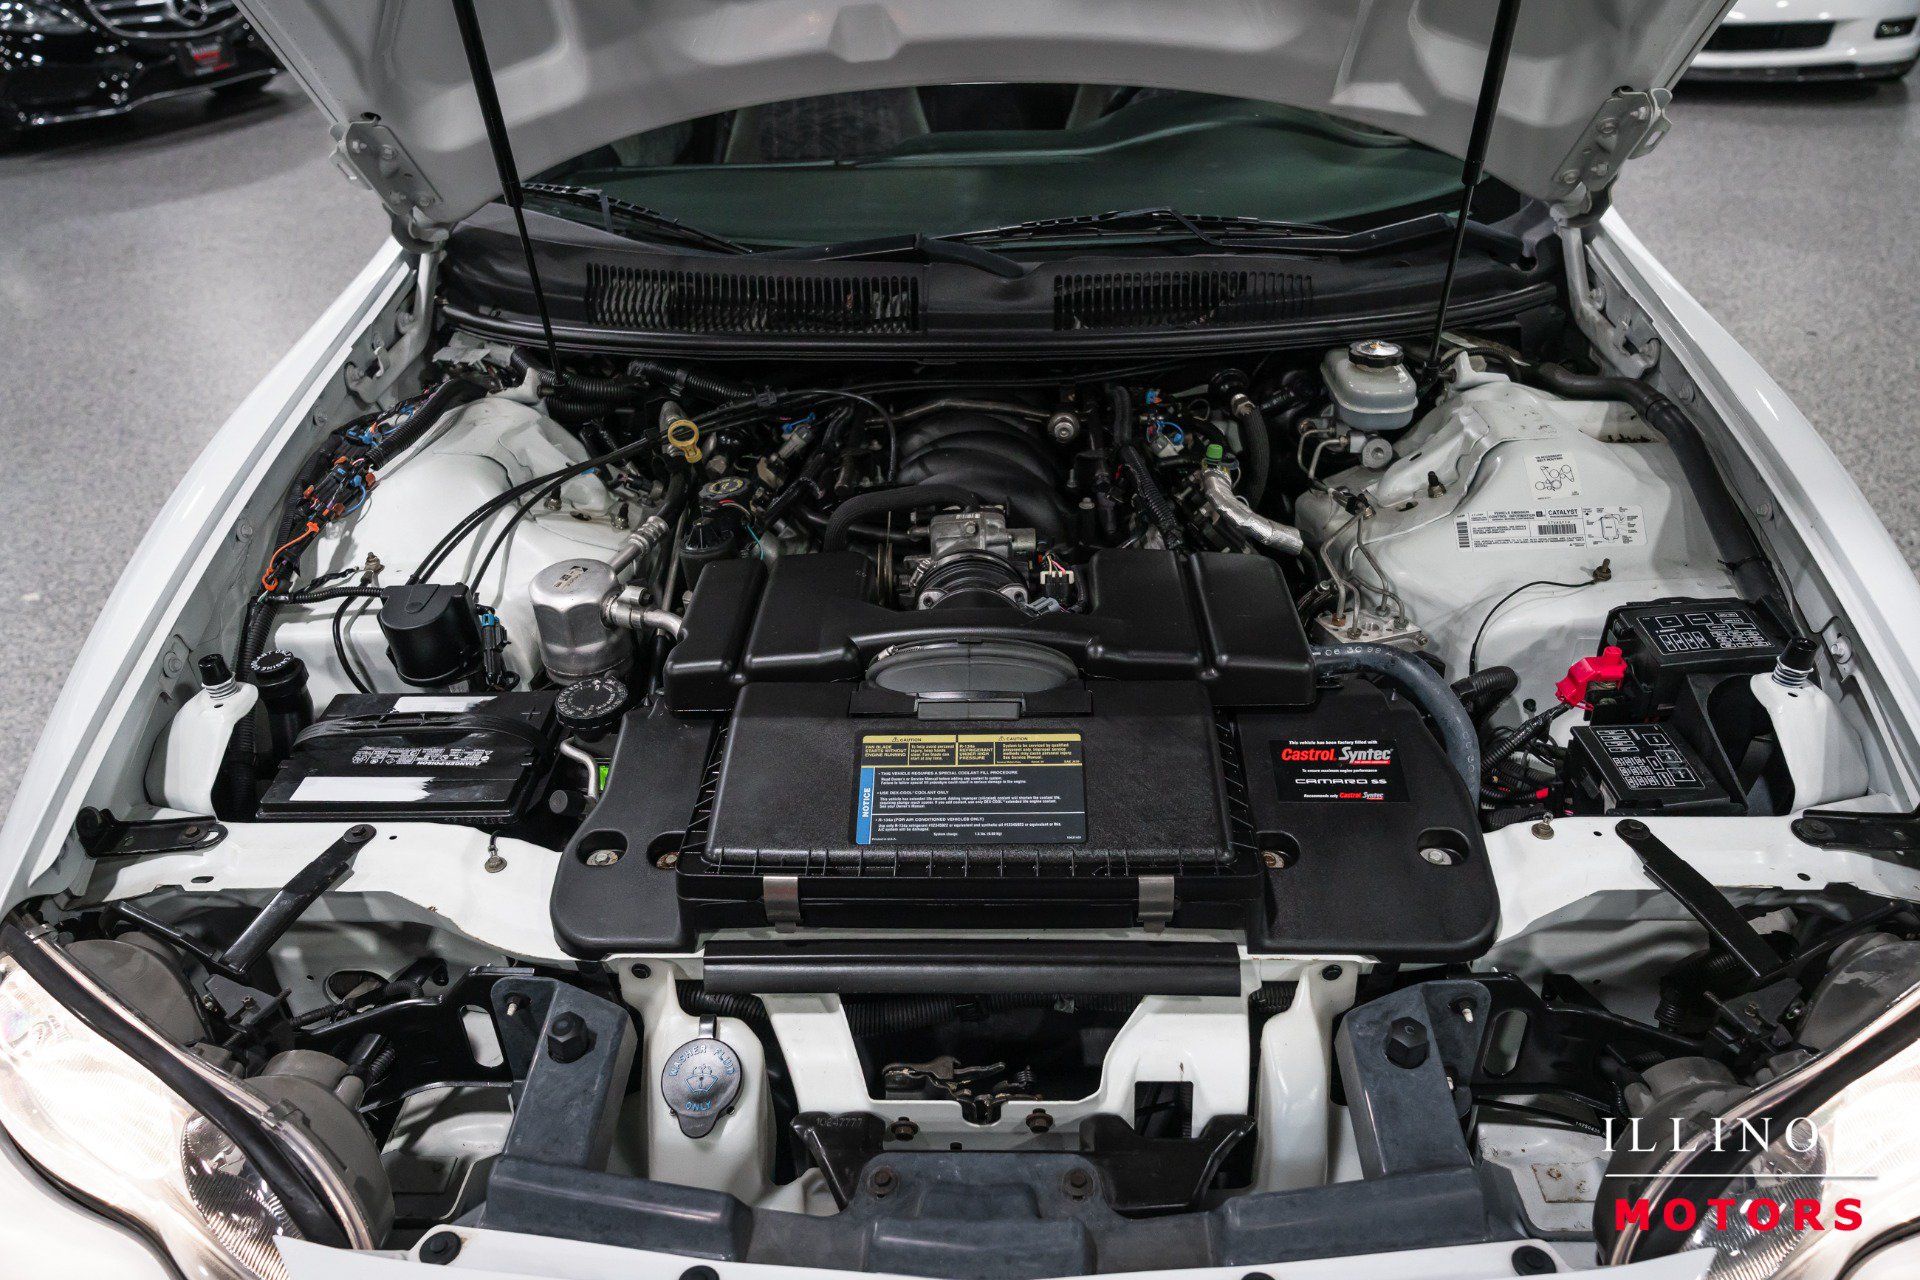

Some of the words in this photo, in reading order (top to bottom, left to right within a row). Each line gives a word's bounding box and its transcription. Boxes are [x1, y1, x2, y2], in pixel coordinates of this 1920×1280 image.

[261, 657, 290, 672] ENGINE
[1282, 748, 1335, 761] Castrol
[1338, 746, 1391, 764] Syntec
[862, 788, 871, 818] NOTICE
[669, 1045, 706, 1076] WASHER
[714, 1048, 736, 1076] FLUID
[685, 1100, 711, 1111] ONLY
